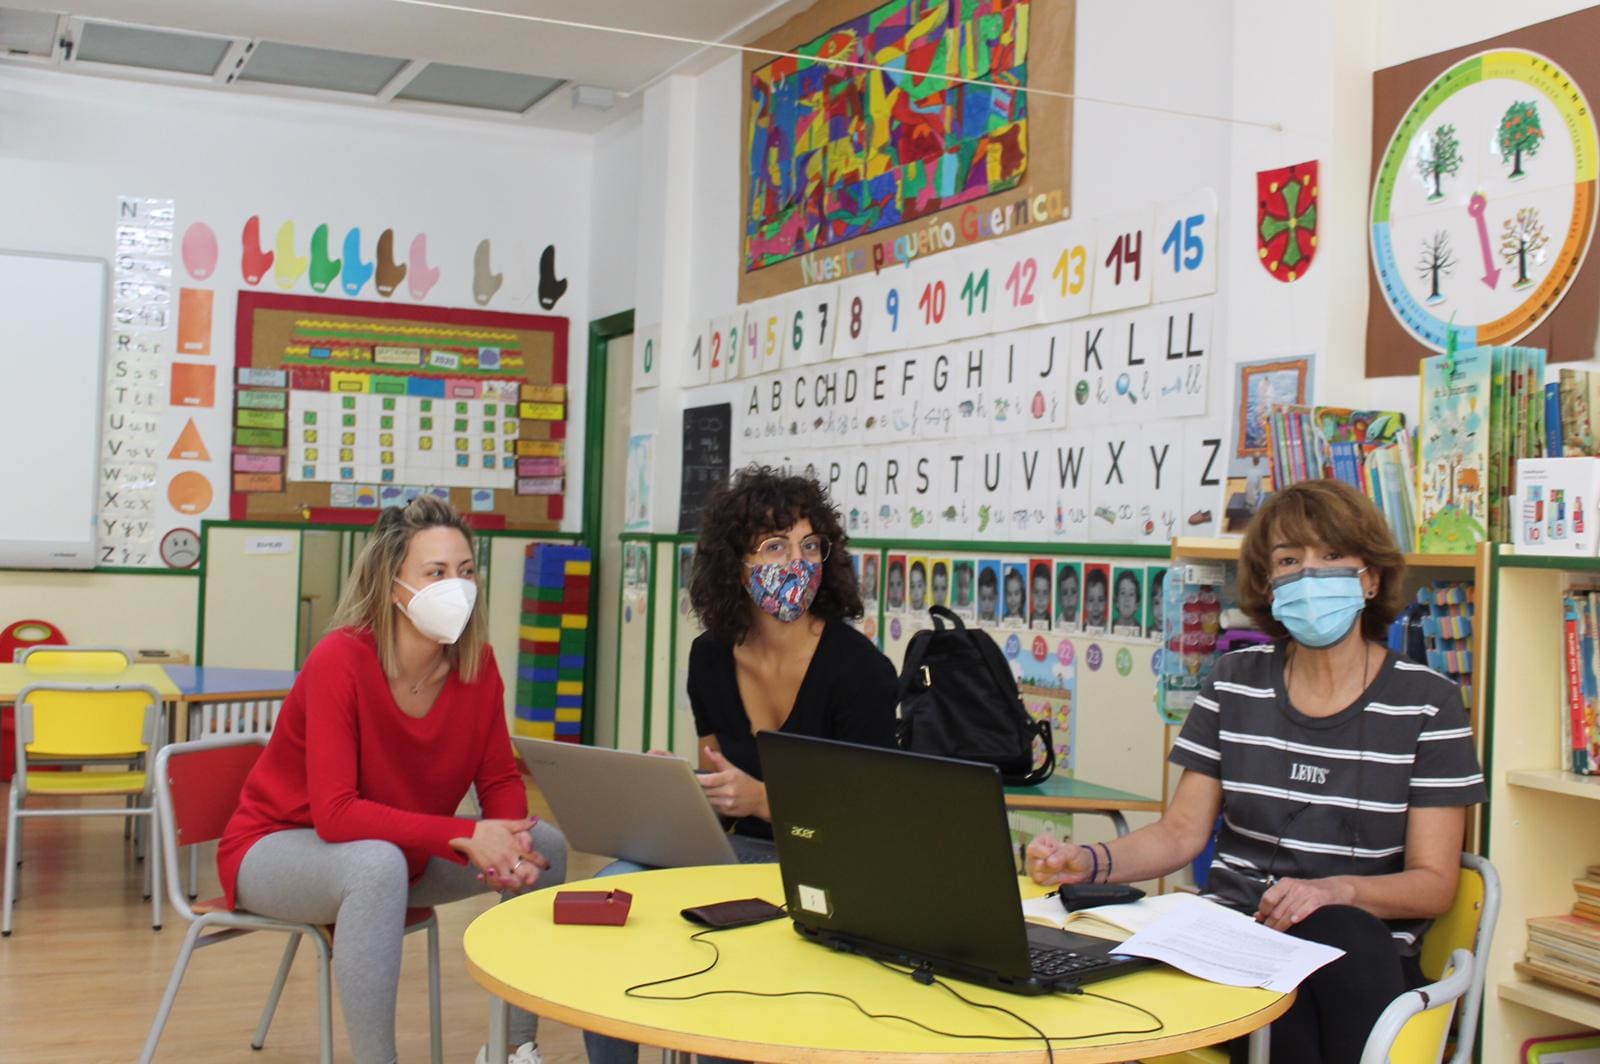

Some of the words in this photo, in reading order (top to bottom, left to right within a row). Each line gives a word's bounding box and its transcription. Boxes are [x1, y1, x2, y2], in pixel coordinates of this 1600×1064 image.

[121, 201, 137, 217] N
[802, 246, 867, 285] Nuestro
[873, 216, 956, 276] pequeño
[960, 186, 1070, 242] Guernica.
[692, 335, 702, 371] 1
[711, 331, 721, 368] 2
[729, 327, 738, 364] 3
[748, 322, 758, 359] 4
[766, 315, 778, 356] 5
[792, 310, 804, 351] 6
[818, 303, 828, 345] 7
[850, 296, 863, 339] 8
[886, 288, 899, 332] 9
[918, 280, 946, 325] 10
[961, 268, 989, 316] 11
[1005, 257, 1038, 307] 12
[1052, 245, 1087, 298] 13
[1105, 230, 1143, 286] 14
[1162, 213, 1205, 273] 15
[118, 335, 130, 352] R
[116, 360, 128, 378] S
[748, 385, 759, 416] A
[771, 381, 782, 411] B
[795, 377, 806, 408] C
[814, 372, 837, 406] CH
[844, 370, 857, 402] D
[874, 365, 886, 400] E
[902, 360, 916, 395] F
[933, 355, 949, 392] G
[967, 349, 983, 389] H
[1008, 344, 1014, 383] I
[1040, 336, 1055, 378] J
[1084, 328, 1103, 372] K
[1128, 322, 1145, 366] L
[1166, 312, 1204, 360] LL
[115, 387, 128, 403] T
[110, 414, 124, 430] U
[108, 440, 123, 456] V
[103, 468, 121, 480] W
[828, 462, 841, 494] P
[855, 461, 868, 496] Q
[886, 459, 899, 495] R
[916, 458, 929, 494] S
[950, 456, 964, 493] T
[985, 452, 1000, 492] U
[1022, 450, 1039, 491] V
[1057, 447, 1085, 489] W
[1105, 440, 1126, 485] X
[1150, 444, 1170, 490] Y
[1200, 439, 1222, 487] Z
[104, 491, 119, 508] X
[103, 519, 118, 536] Y
[102, 546, 115, 562] Z
[1034, 641, 1045, 655] 21
[1060, 641, 1072, 658] 22
[1087, 649, 1100, 665] 23
[791, 826, 816, 839] acer
